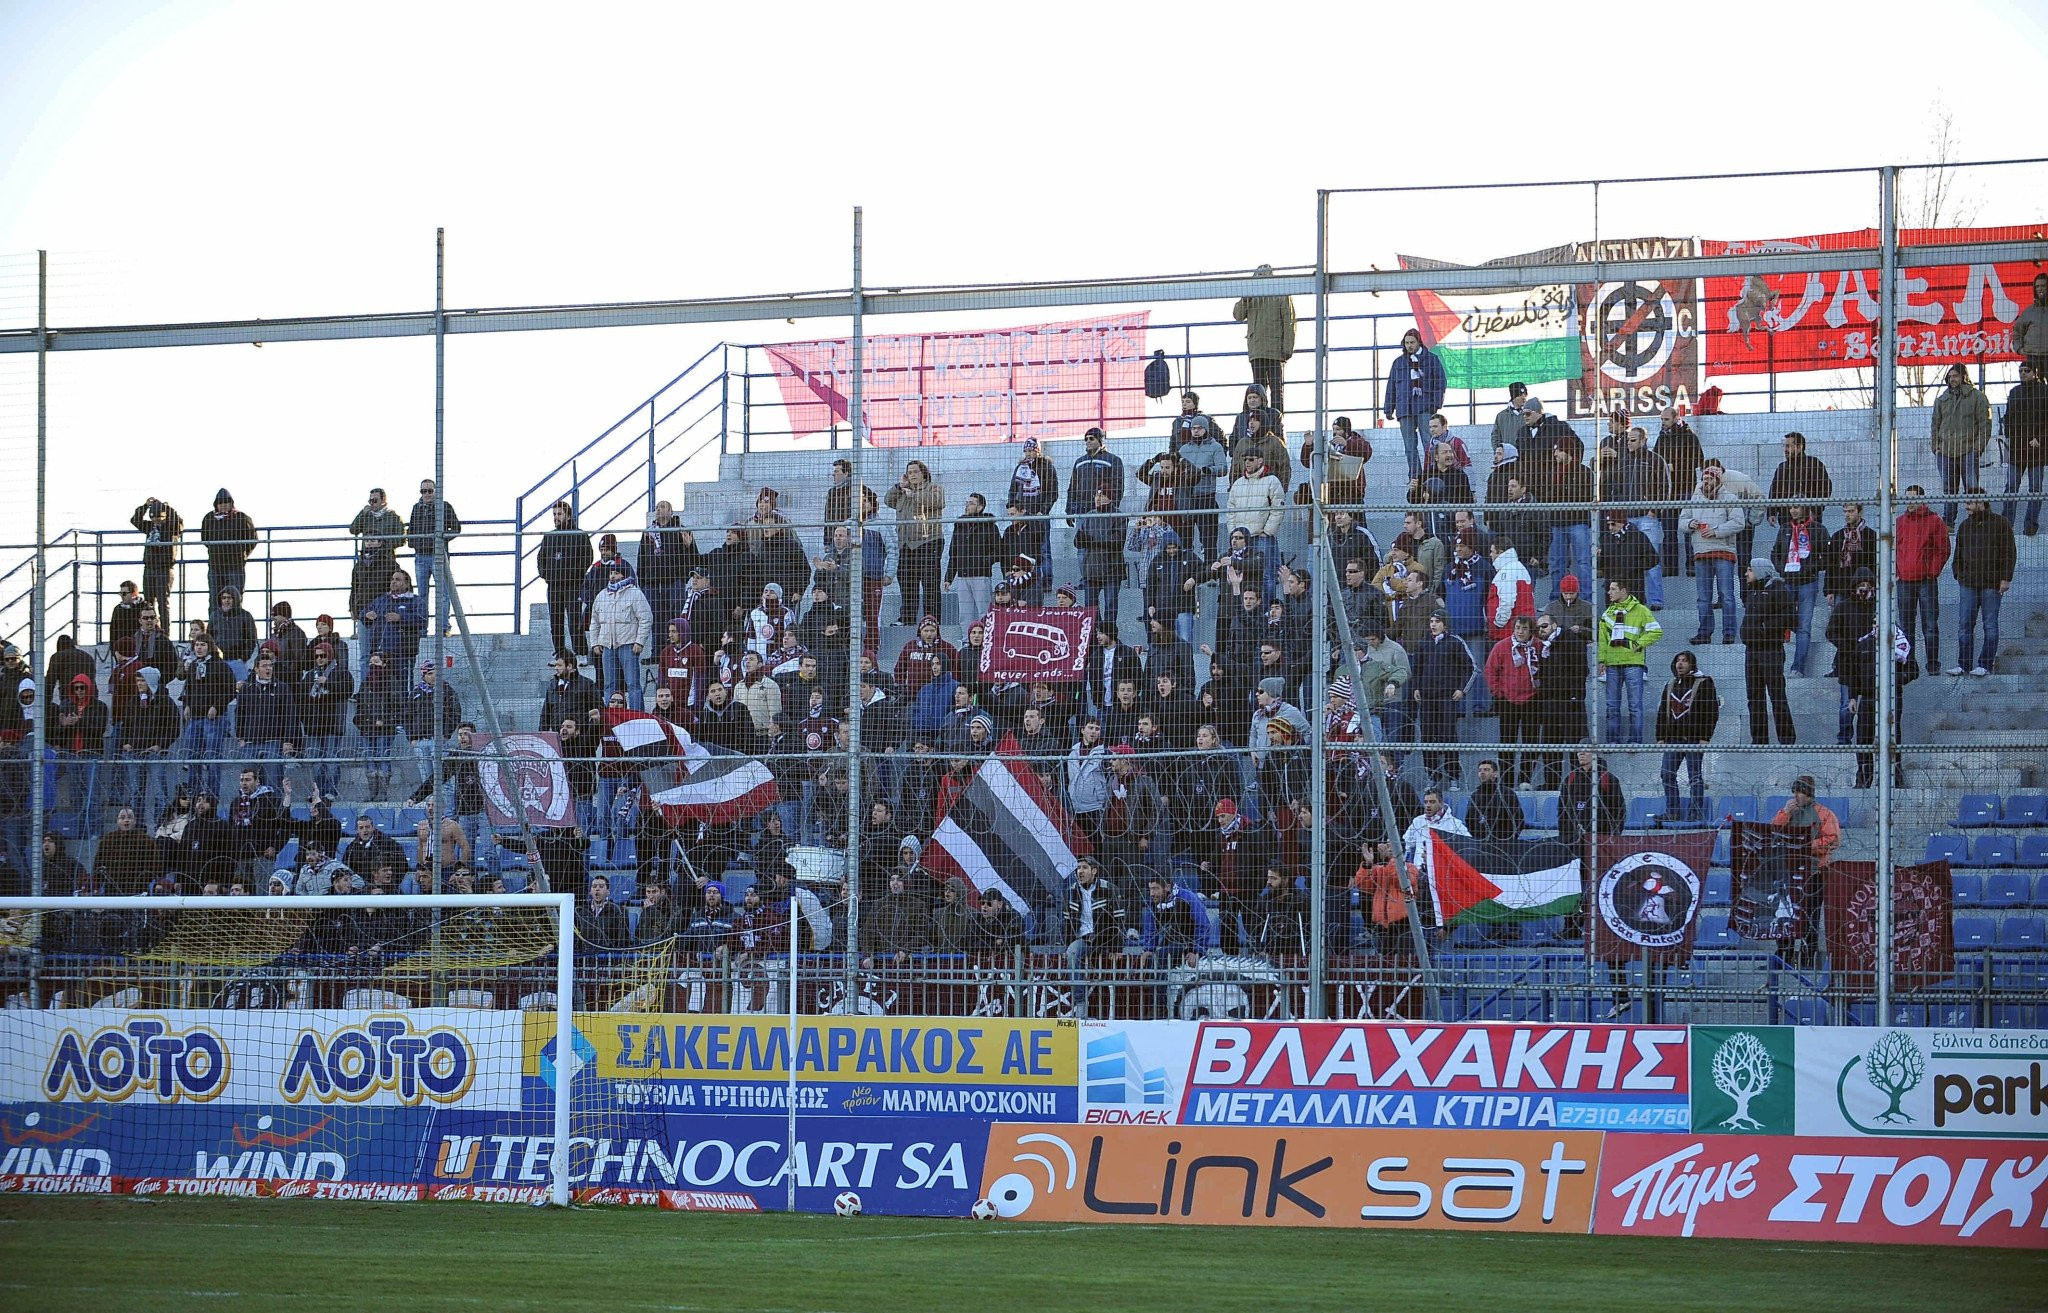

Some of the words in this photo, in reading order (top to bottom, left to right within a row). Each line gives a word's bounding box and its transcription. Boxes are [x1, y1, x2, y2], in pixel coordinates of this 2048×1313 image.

[1576, 240, 1689, 263] ANTINAZI
[1574, 384, 1693, 416] LARISSA
[993, 670, 1028, 680] never
[616, 1024, 984, 1074] ΣΑΚΕΛΛΑΡΑΚΟΣ
[1001, 1029, 1053, 1075] ΑΕ
[1932, 1032, 1983, 1052] ξύλινα
[1988, 1033, 2048, 1050] δάπεδα
[44, 1017, 229, 1101] ΛΟΤΤΟ
[280, 1016, 475, 1102] ΛΟΤΤΟ
[1192, 1025, 1687, 1091] ΒΛΑΧΑΚΗΣ
[614, 1083, 696, 1106] ΤΟΥΒΛΑ
[701, 1085, 829, 1109] ΤΡΙΠΟΛΕΩΣ
[841, 1096, 881, 1114] προϊόν
[851, 1086, 872, 1099] Νέο
[882, 1089, 1057, 1115] ΜΑΡΜΑΡΟΣΚΟΝΗ
[1933, 1061, 2048, 1128] park
[1194, 1092, 1418, 1125] ΜΕΤΑΛΛΙΚΑ
[1432, 1095, 1558, 1128] ΚΤΙΡΙΑ
[1560, 1107, 1690, 1127] 27310.44760
[196, 1150, 346, 1183] WIND
[489, 1135, 893, 1188] TECHNOCART
[895, 1141, 969, 1190] SA
[22, 1176, 112, 1194] ΣΤΟΙΧΗΜΑ
[133, 1177, 162, 1195] Πάμε
[164, 1178, 257, 1197] ΣΤΟΙΧΗΜΑ
[277, 1179, 311, 1198] Πάμε
[315, 1181, 418, 1201] ΣΤΟΙΧΗΜΑ
[1083, 1135, 1334, 1218] Link
[1361, 1141, 1587, 1224] sat
[1611, 1143, 1760, 1238] Πάμε
[1767, 1154, 2048, 1237] ΣΤΟΙΧ
[694, 1192, 758, 1210] ΣΤΟΙΧΗΜΑ
